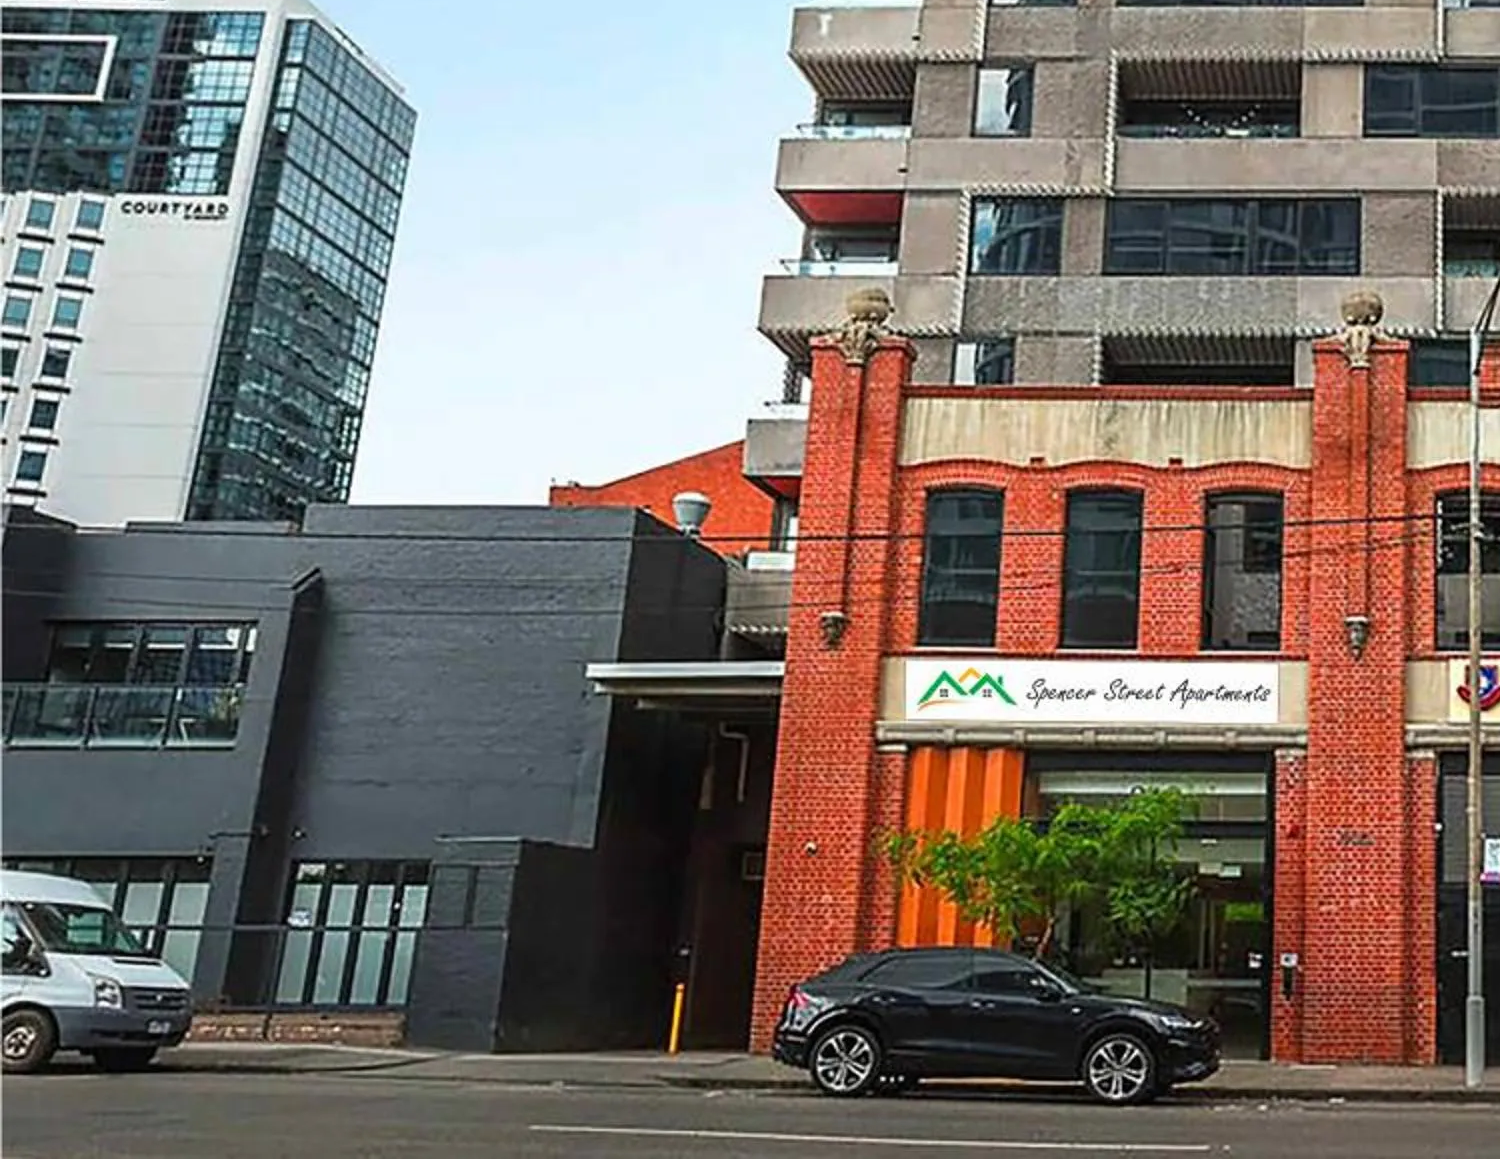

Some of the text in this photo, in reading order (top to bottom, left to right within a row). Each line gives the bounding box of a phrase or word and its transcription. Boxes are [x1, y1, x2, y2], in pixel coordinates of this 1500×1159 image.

[120, 200, 229, 215] COURTYARD
[1025, 677, 1272, 710] Spencer Street Apartments
